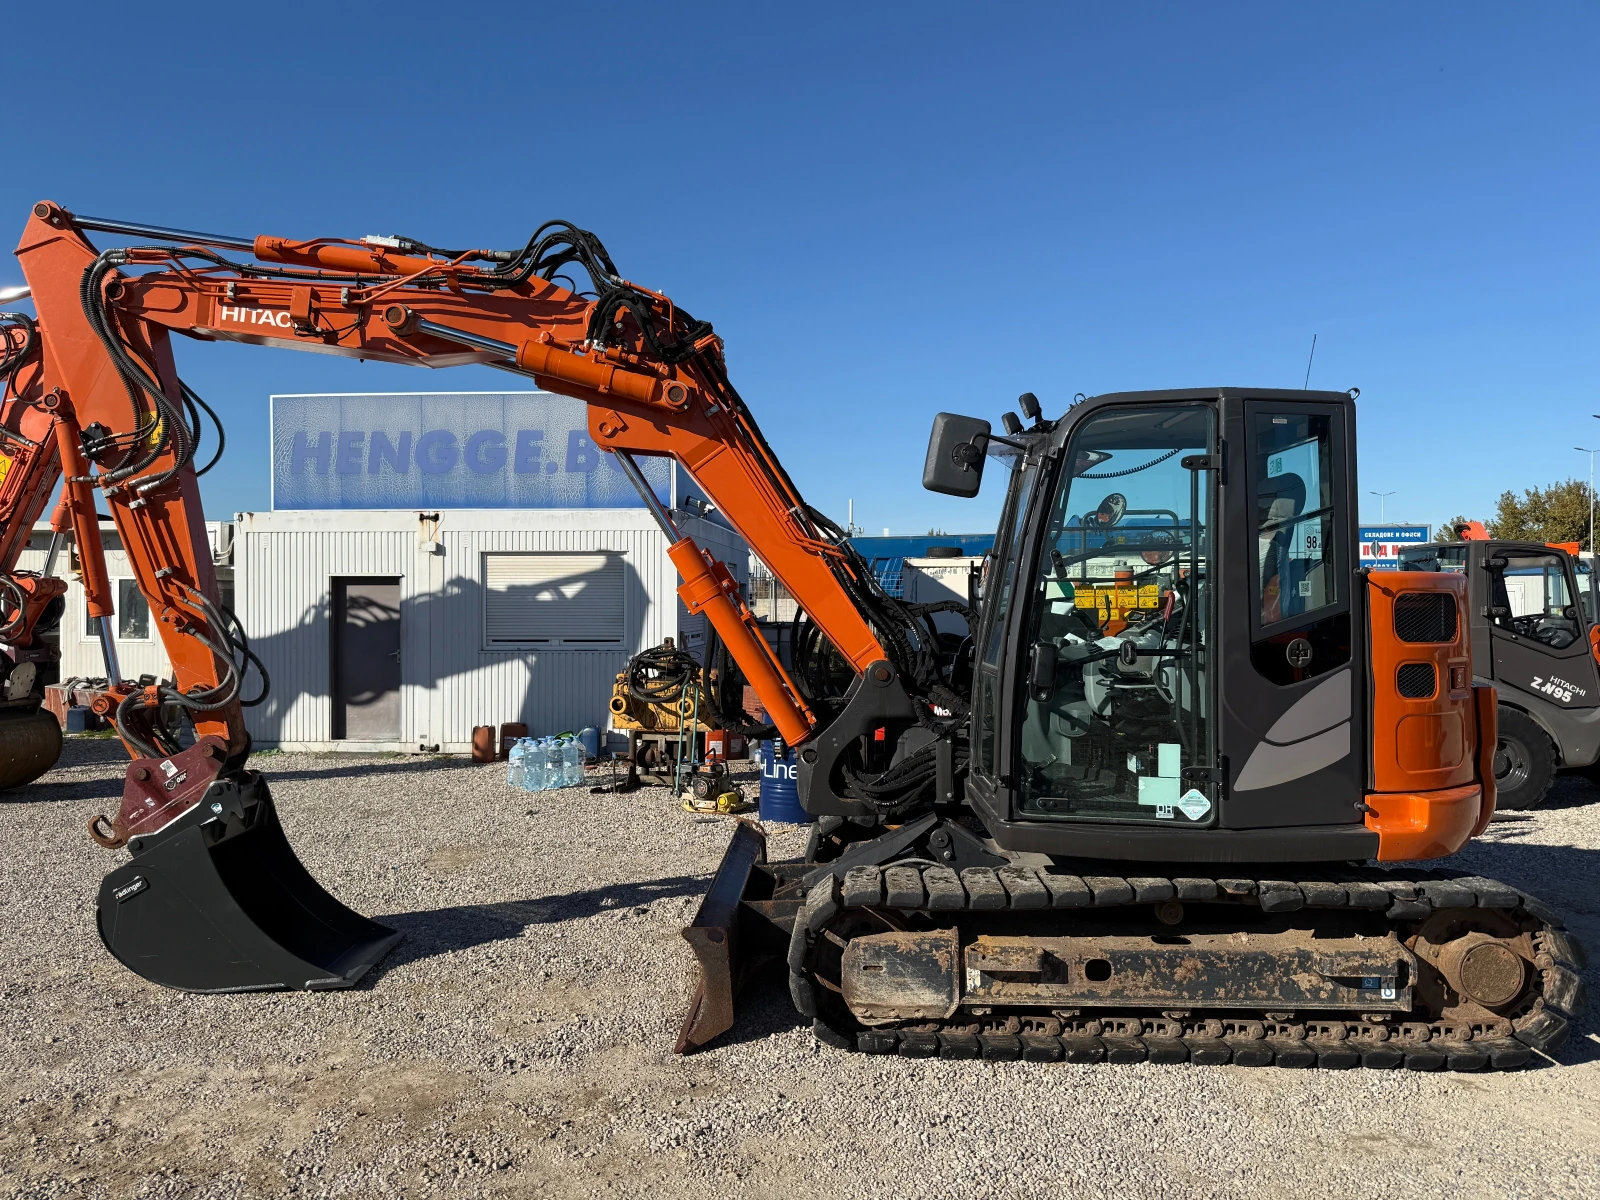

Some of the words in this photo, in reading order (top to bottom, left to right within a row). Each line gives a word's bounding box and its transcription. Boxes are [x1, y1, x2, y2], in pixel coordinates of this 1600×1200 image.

[221, 305, 297, 328] HITAC
[291, 428, 648, 474] HENGGE.B
[1306, 535, 1317, 549] 98
[1362, 544, 1388, 557] ПД
[1550, 675, 1586, 697] HITACHI
